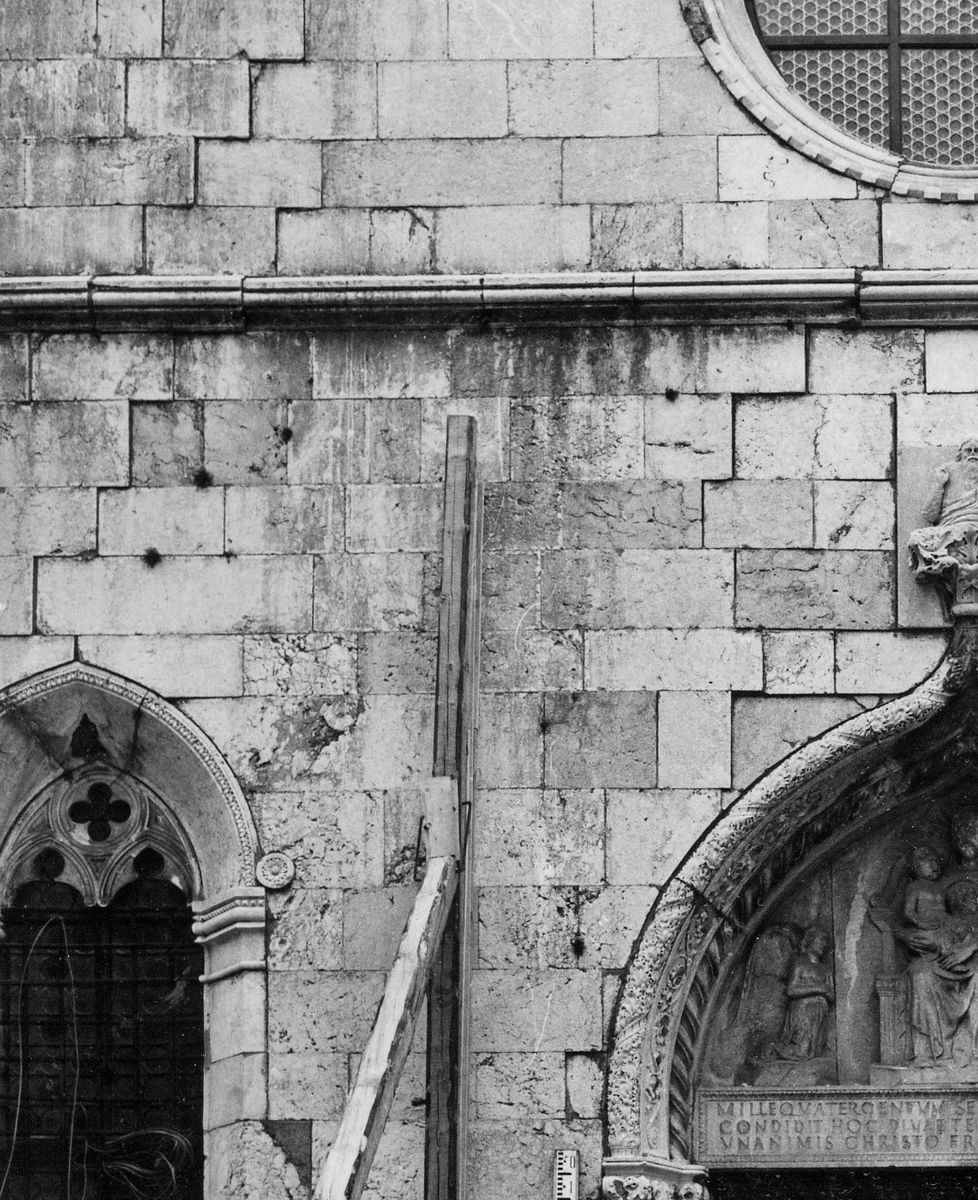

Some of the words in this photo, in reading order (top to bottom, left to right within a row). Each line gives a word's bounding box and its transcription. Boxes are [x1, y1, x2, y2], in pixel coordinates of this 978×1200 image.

[719, 1119, 822, 1134] CONDIDIT
[831, 1119, 878, 1134] HOC
[720, 1136, 833, 1150] VNANIMIS
[845, 1135, 939, 1150] CHRISTO
[570, 1156, 575, 1168] 0
